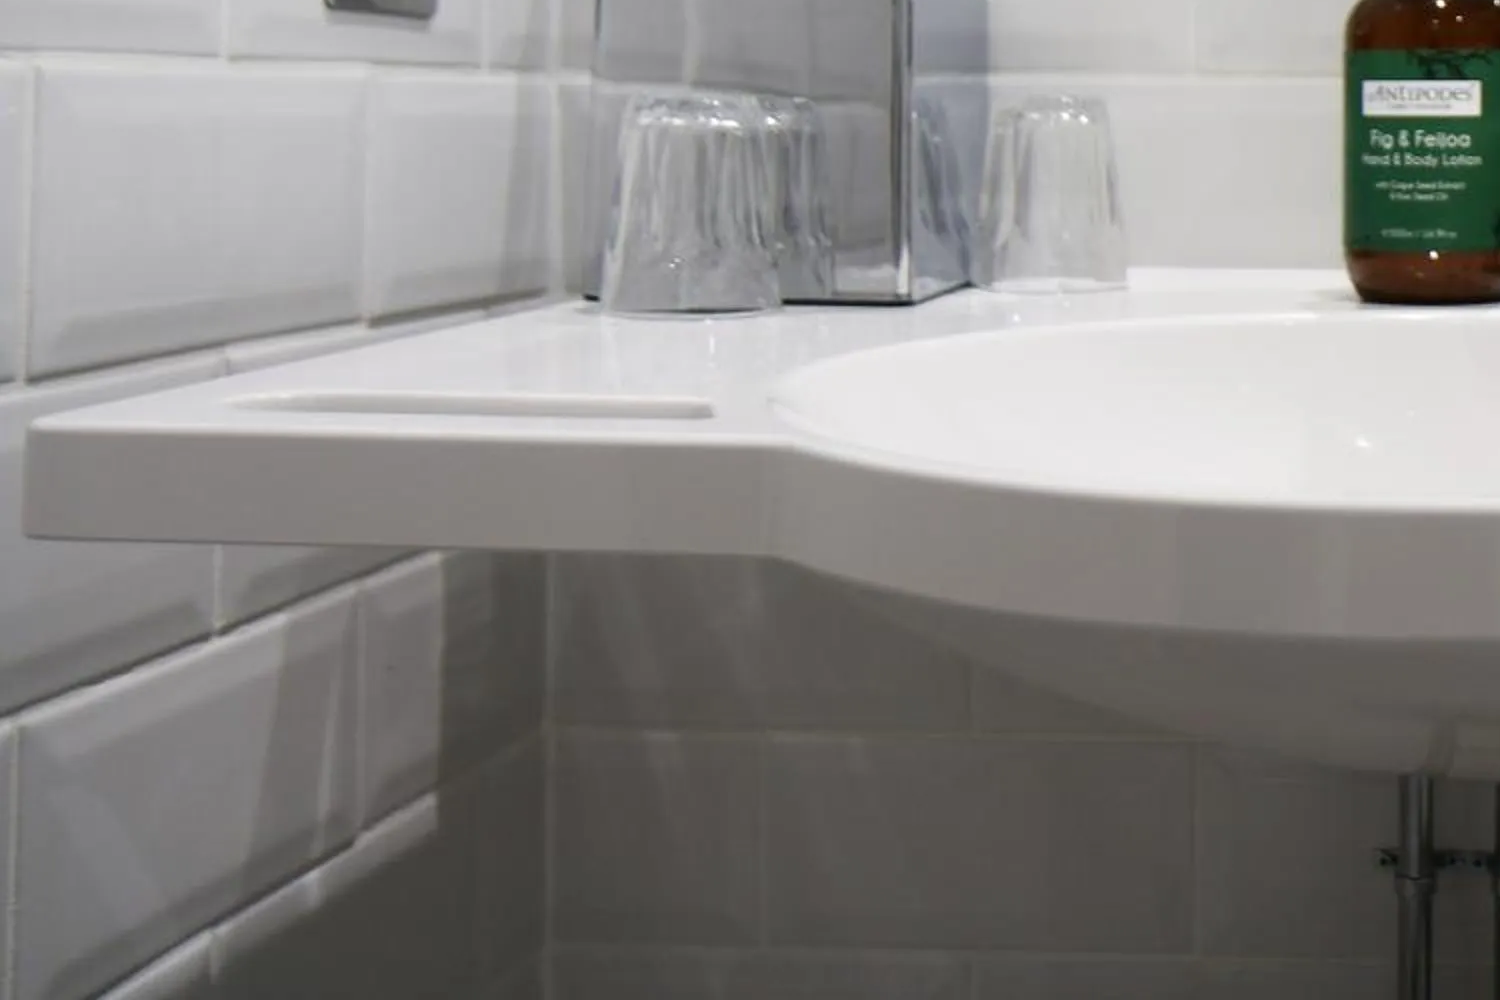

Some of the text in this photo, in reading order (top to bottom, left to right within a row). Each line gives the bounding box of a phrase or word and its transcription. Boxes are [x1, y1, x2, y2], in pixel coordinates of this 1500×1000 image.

[1369, 128, 1473, 150] Fig & Feijoa
[1404, 151, 1439, 168] Body
